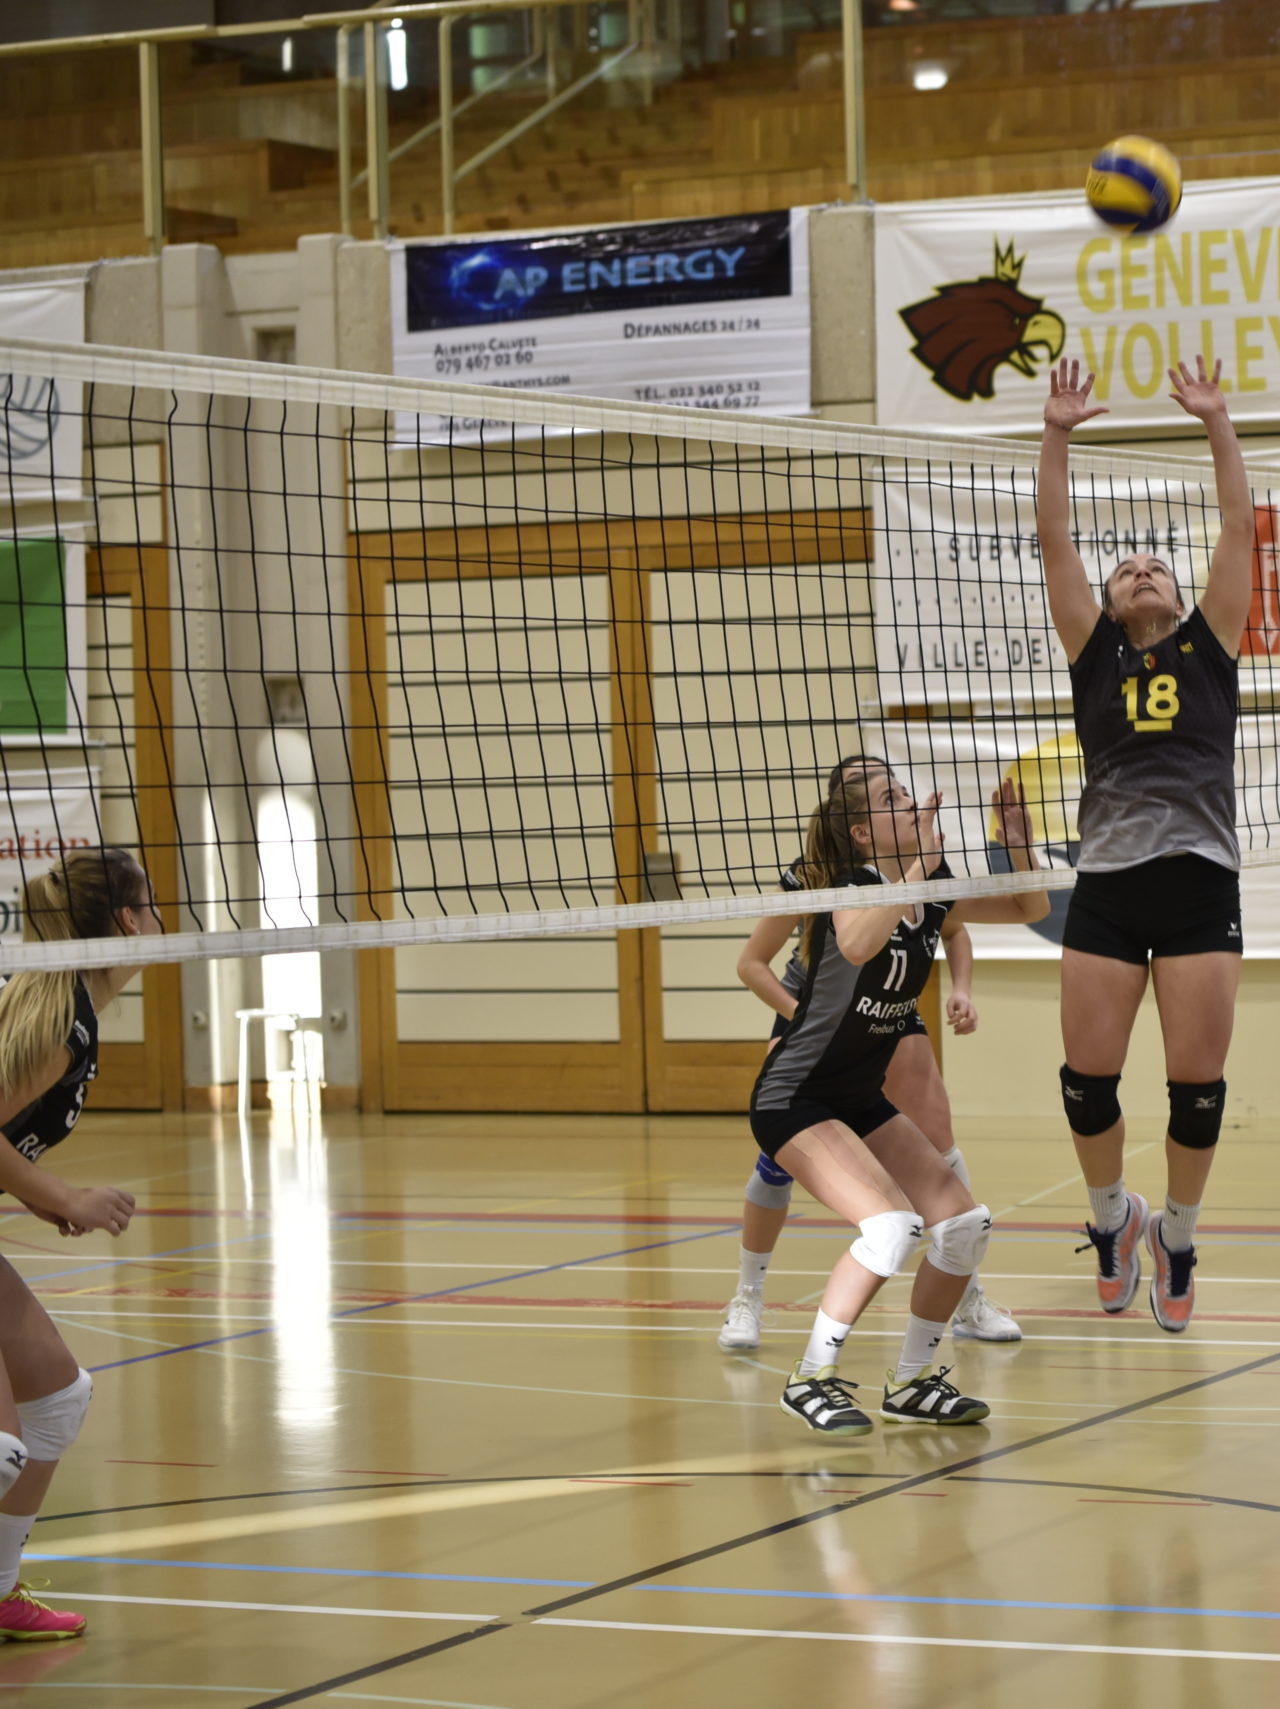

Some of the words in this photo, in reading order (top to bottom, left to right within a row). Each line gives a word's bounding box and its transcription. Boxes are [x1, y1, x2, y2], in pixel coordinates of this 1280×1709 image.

[561, 246, 747, 293] ENERGY
[436, 357, 462, 374] 079
[466, 355, 491, 370] 467
[514, 350, 534, 364] 60
[949, 520, 1179, 562] SUBVETIONNÉ
[1121, 674, 1180, 721] 18
[883, 948, 908, 992] 11
